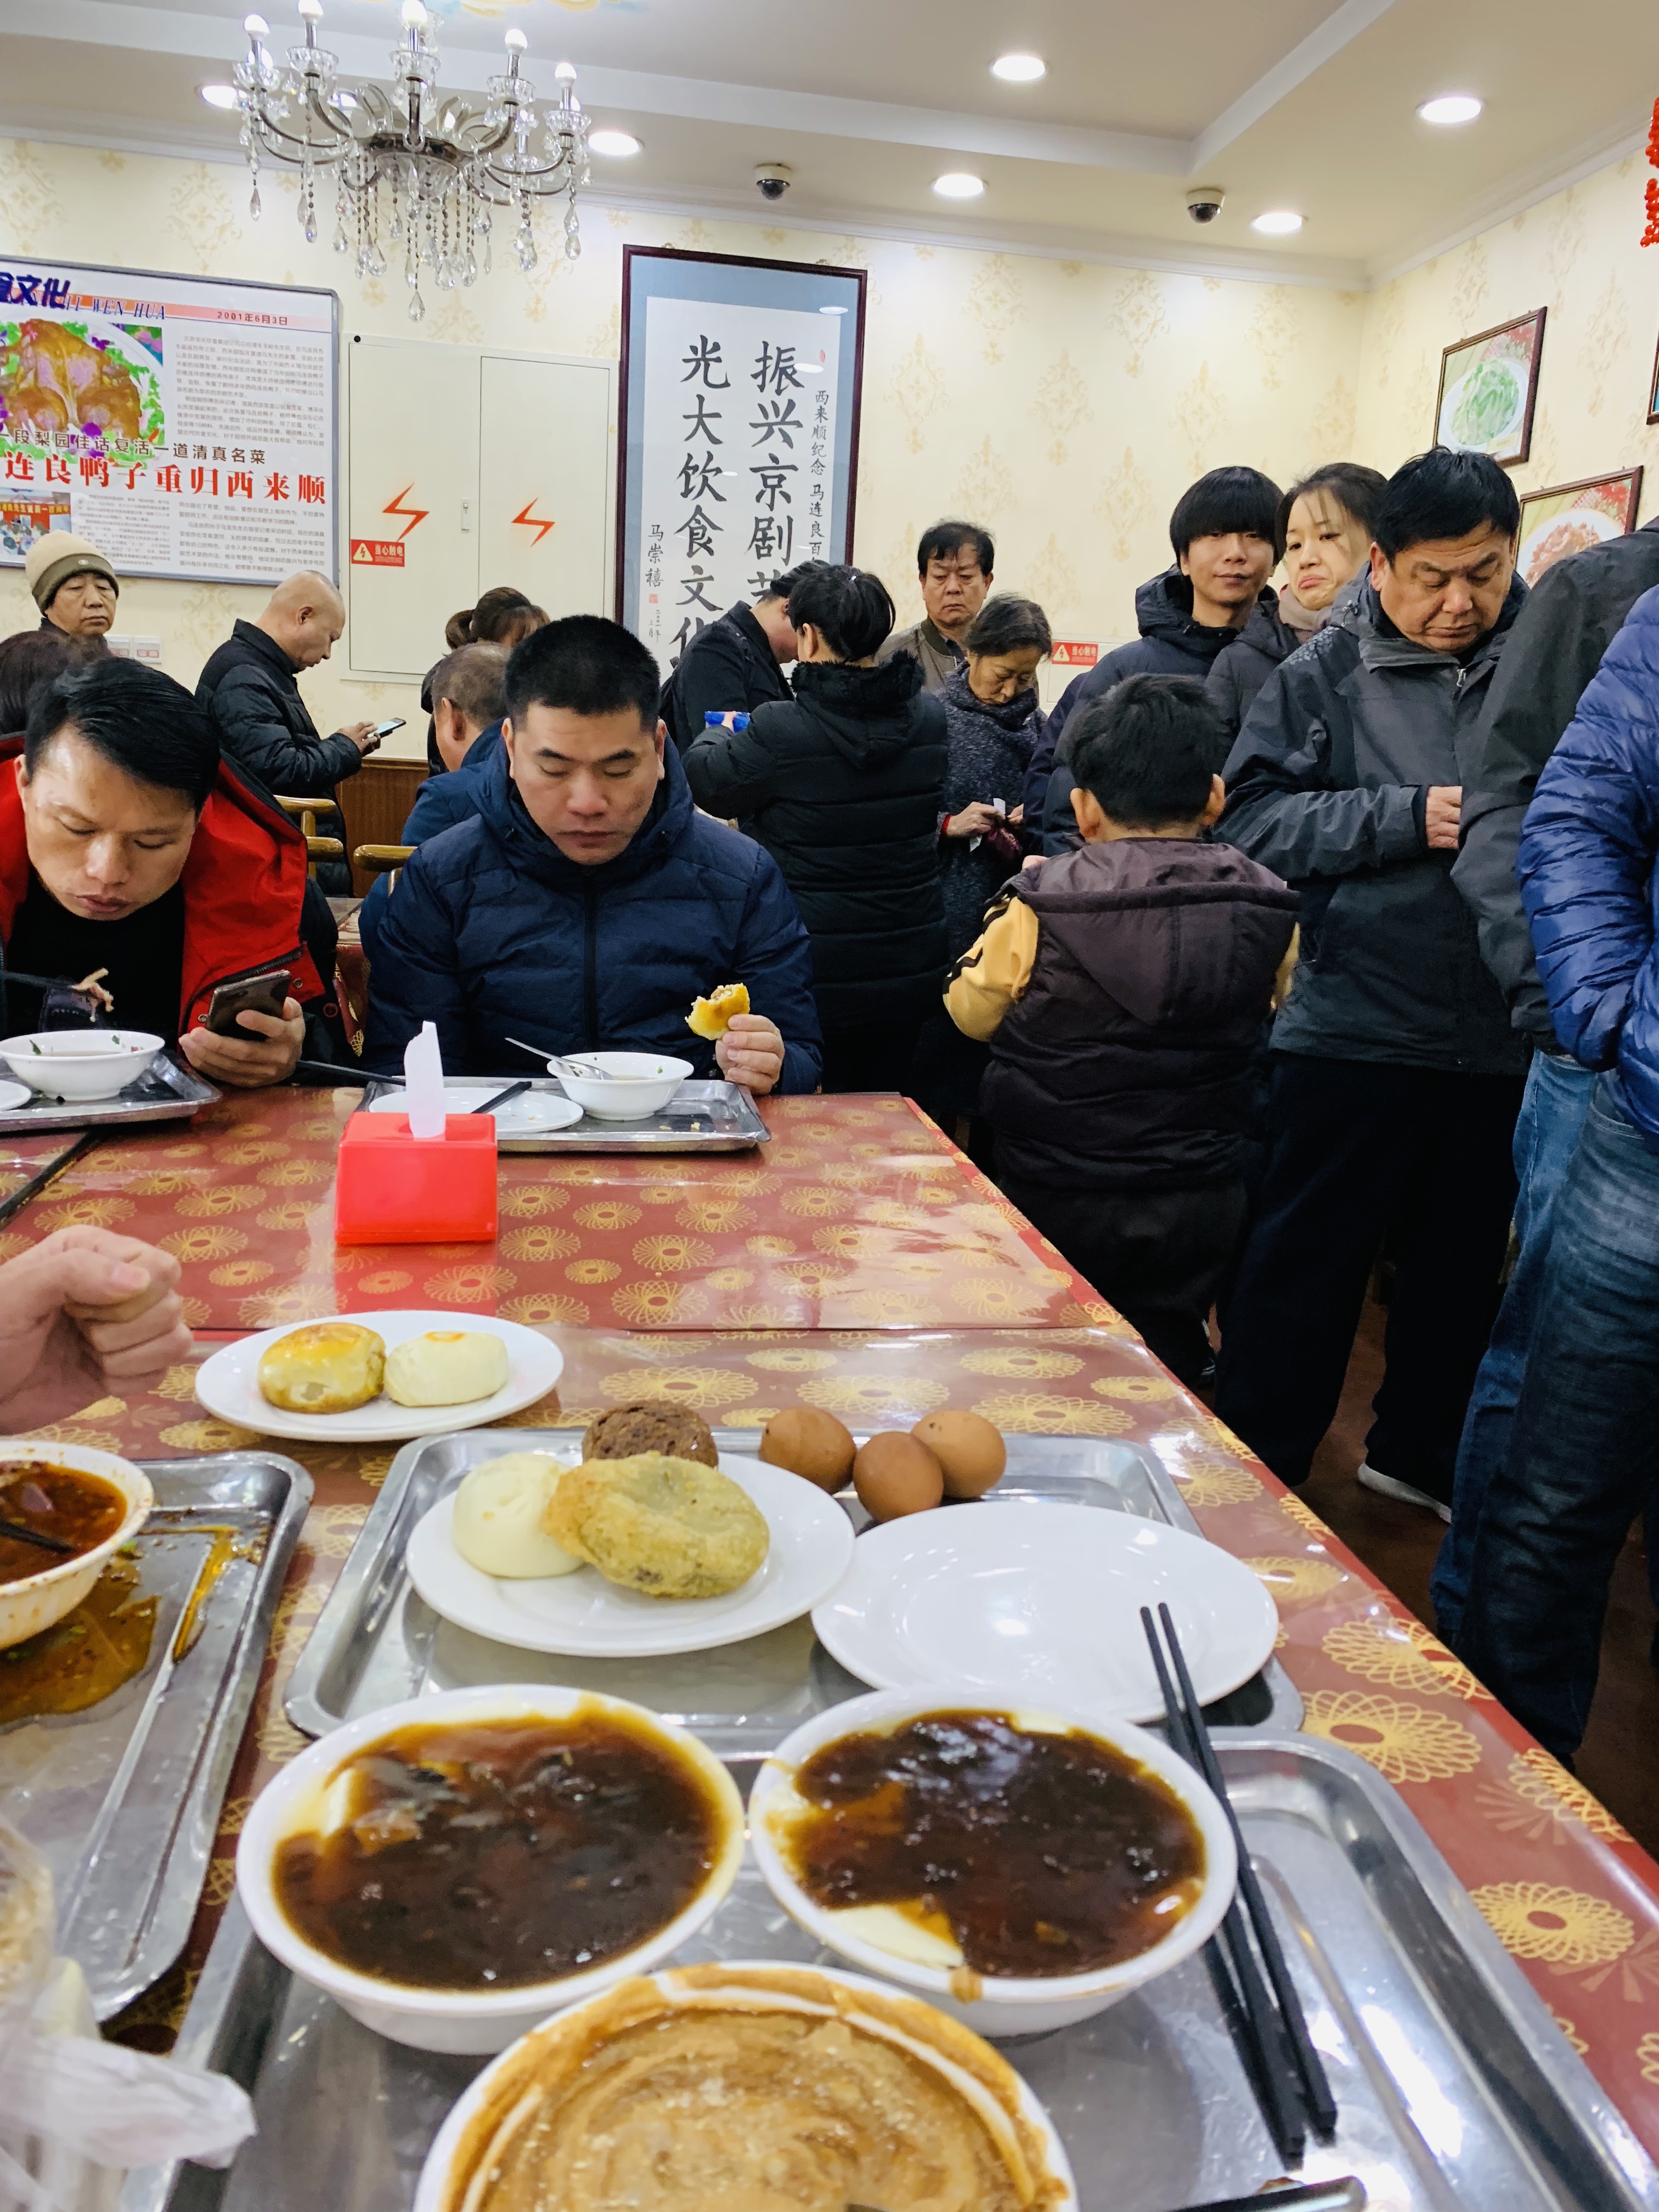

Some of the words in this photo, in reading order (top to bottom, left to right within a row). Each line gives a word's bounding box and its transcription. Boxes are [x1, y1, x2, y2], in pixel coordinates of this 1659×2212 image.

[92, 298, 125, 315] WEN
[133, 302, 165, 320] HUA
[217, 311, 287, 325] 2001年6月3日
[0, 429, 266, 464] 一段梨园佳话复活一道清真名菜
[810, 390, 830, 476] 西来顺纪念
[4, 450, 326, 505] 连良鸭子重归西来顺
[809, 484, 825, 561] 马连良百
[375, 544, 404, 557] 当心触电
[645, 524, 664, 588] 马崇禧
